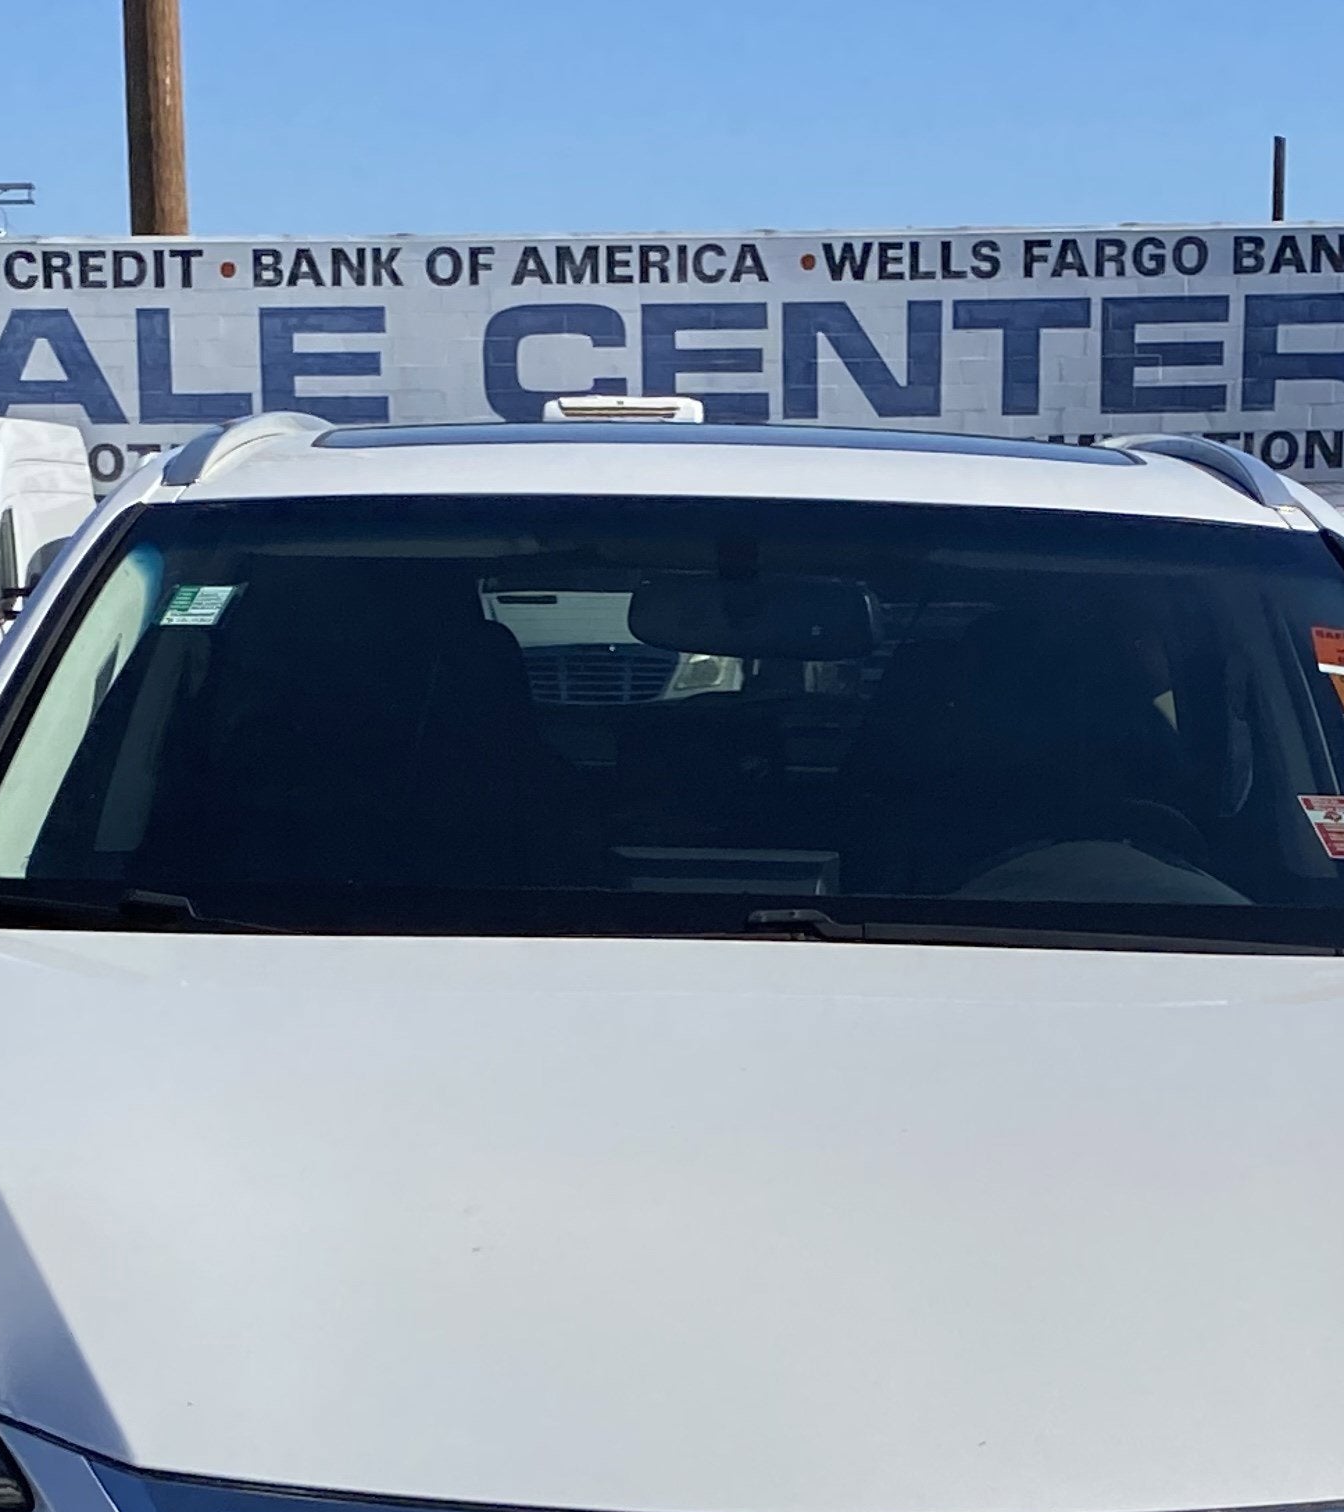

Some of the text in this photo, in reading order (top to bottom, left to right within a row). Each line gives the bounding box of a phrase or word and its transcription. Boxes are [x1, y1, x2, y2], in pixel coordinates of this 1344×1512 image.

[3, 247, 204, 291] CREDIT
[252, 242, 770, 289] BANK OF AMERICA
[821, 237, 1002, 282] WELLS
[1022, 234, 1209, 279] FARGO
